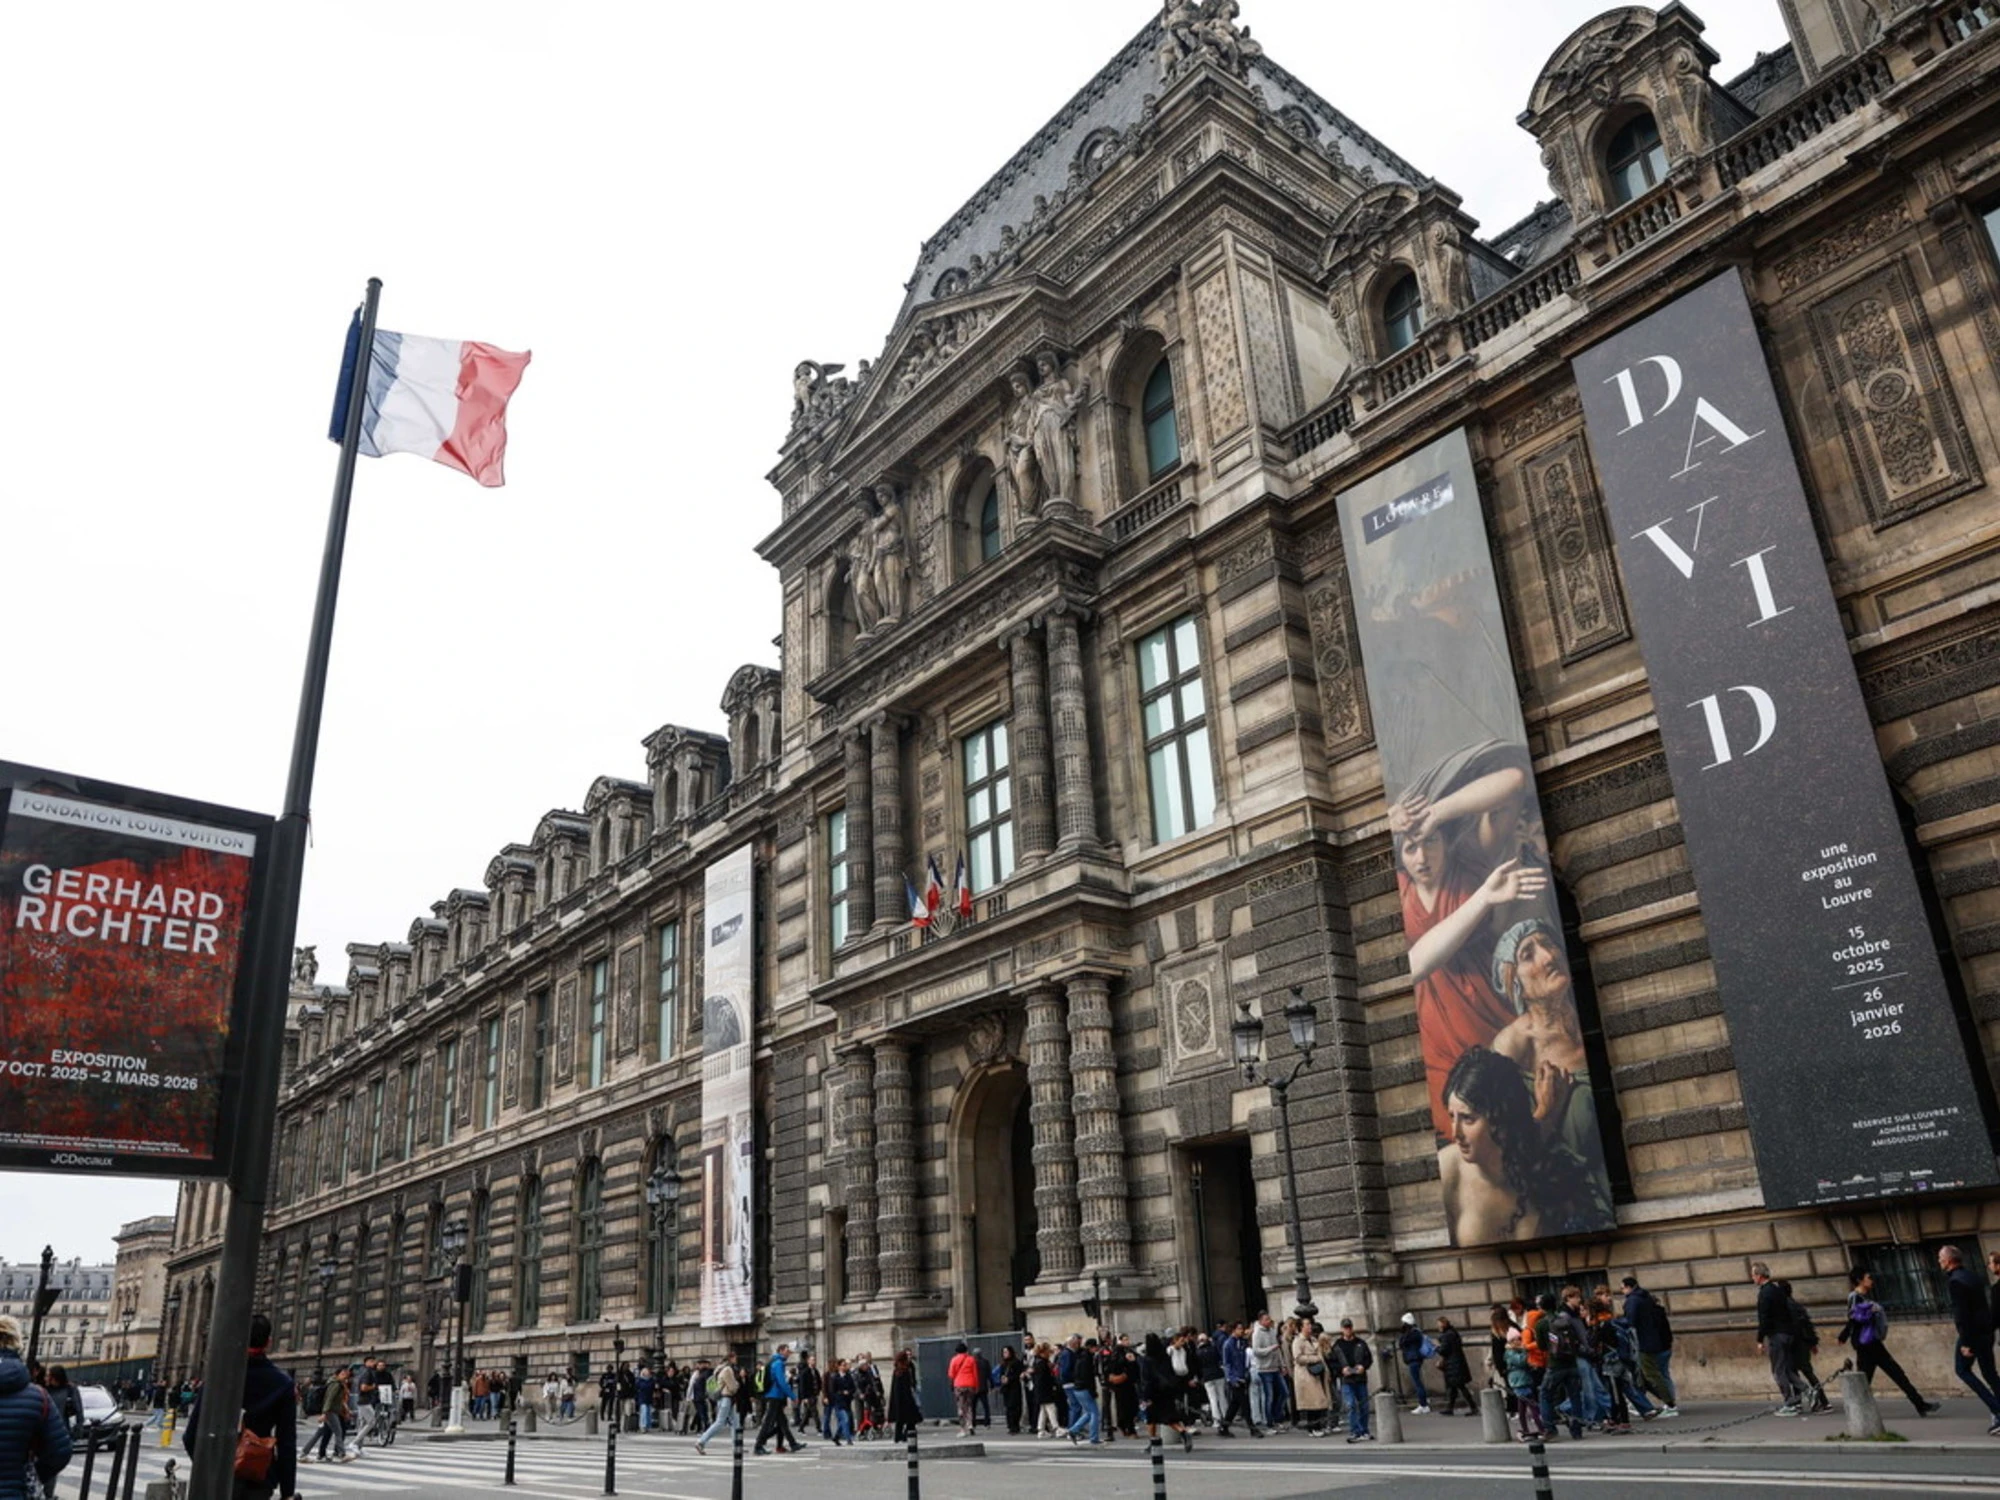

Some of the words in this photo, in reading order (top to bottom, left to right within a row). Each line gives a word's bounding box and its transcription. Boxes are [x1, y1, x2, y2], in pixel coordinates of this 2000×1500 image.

[21, 797, 122, 827] FONDATION
[127, 816, 173, 837] LOUIS
[179, 828, 245, 849] VUITTON
[1820, 842, 1848, 859] une
[1801, 852, 1878, 882] exposition
[22, 863, 224, 921] GERHARD
[1834, 876, 1853, 890] au
[1821, 887, 1873, 910] Louvre
[16, 895, 219, 956] RICHTER
[1848, 925, 1865, 940] 15
[1832, 939, 1891, 963] octobre
[1847, 957, 1885, 976] 2025
[1863, 986, 1883, 1003] 26
[1850, 1002, 1904, 1028] janvier
[1863, 1020, 1902, 1040] 2026
[51, 1049, 147, 1070] EXPOSITION
[9, 1061, 46, 1078] OCT.
[50, 1066, 88, 1081] 2025
[101, 1071, 111, 1084] 2
[115, 1072, 160, 1088] MARS
[163, 1076, 199, 1091] 2026
[50, 1152, 114, 1167] JCDecaux
